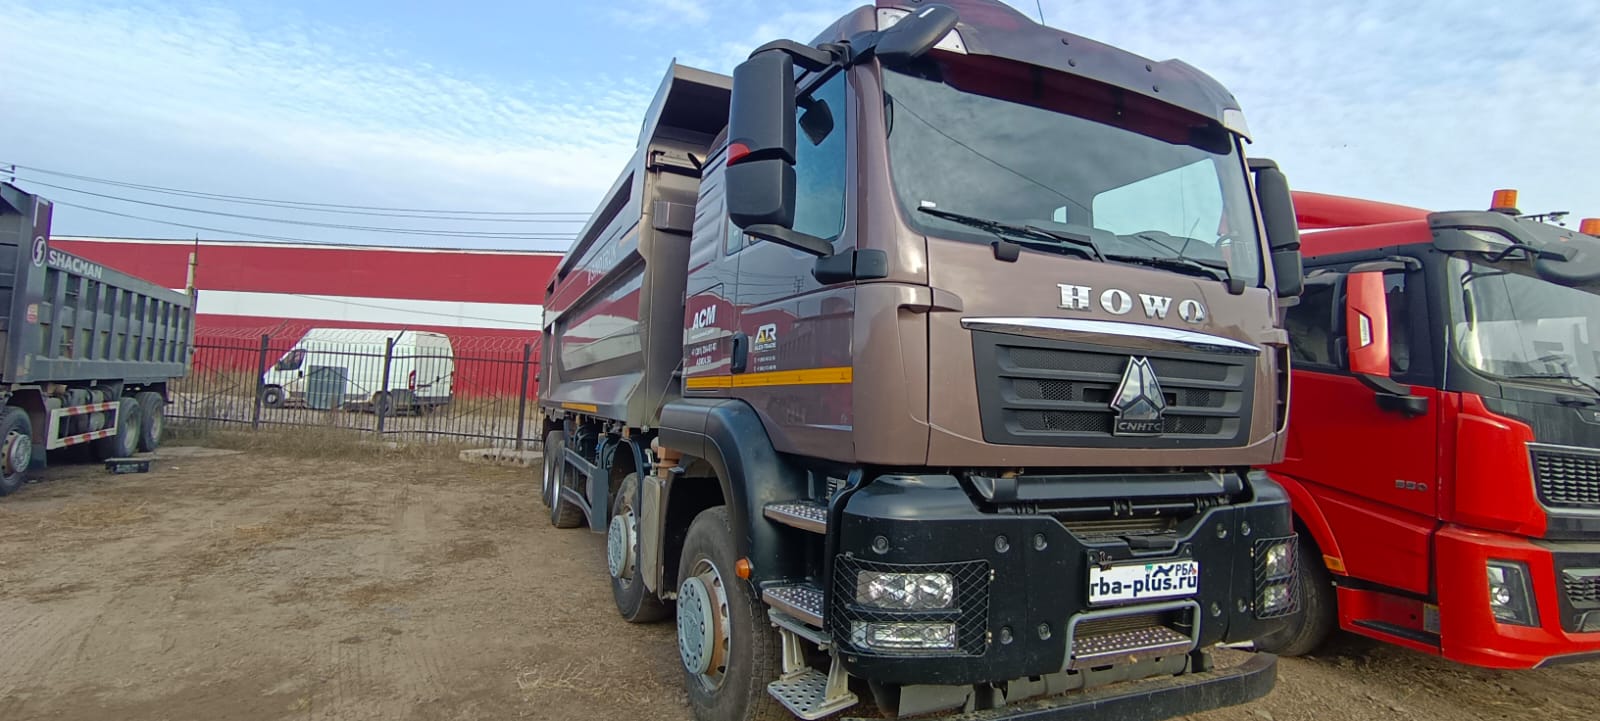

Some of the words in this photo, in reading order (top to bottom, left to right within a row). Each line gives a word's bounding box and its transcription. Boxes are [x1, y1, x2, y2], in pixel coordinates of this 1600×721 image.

[49, 250, 103, 279] SHACMAN
[1057, 283, 1206, 324] HOWO
[1118, 422, 1161, 432] CNHTC
[1090, 574, 1197, 597] rba-plus.ru
